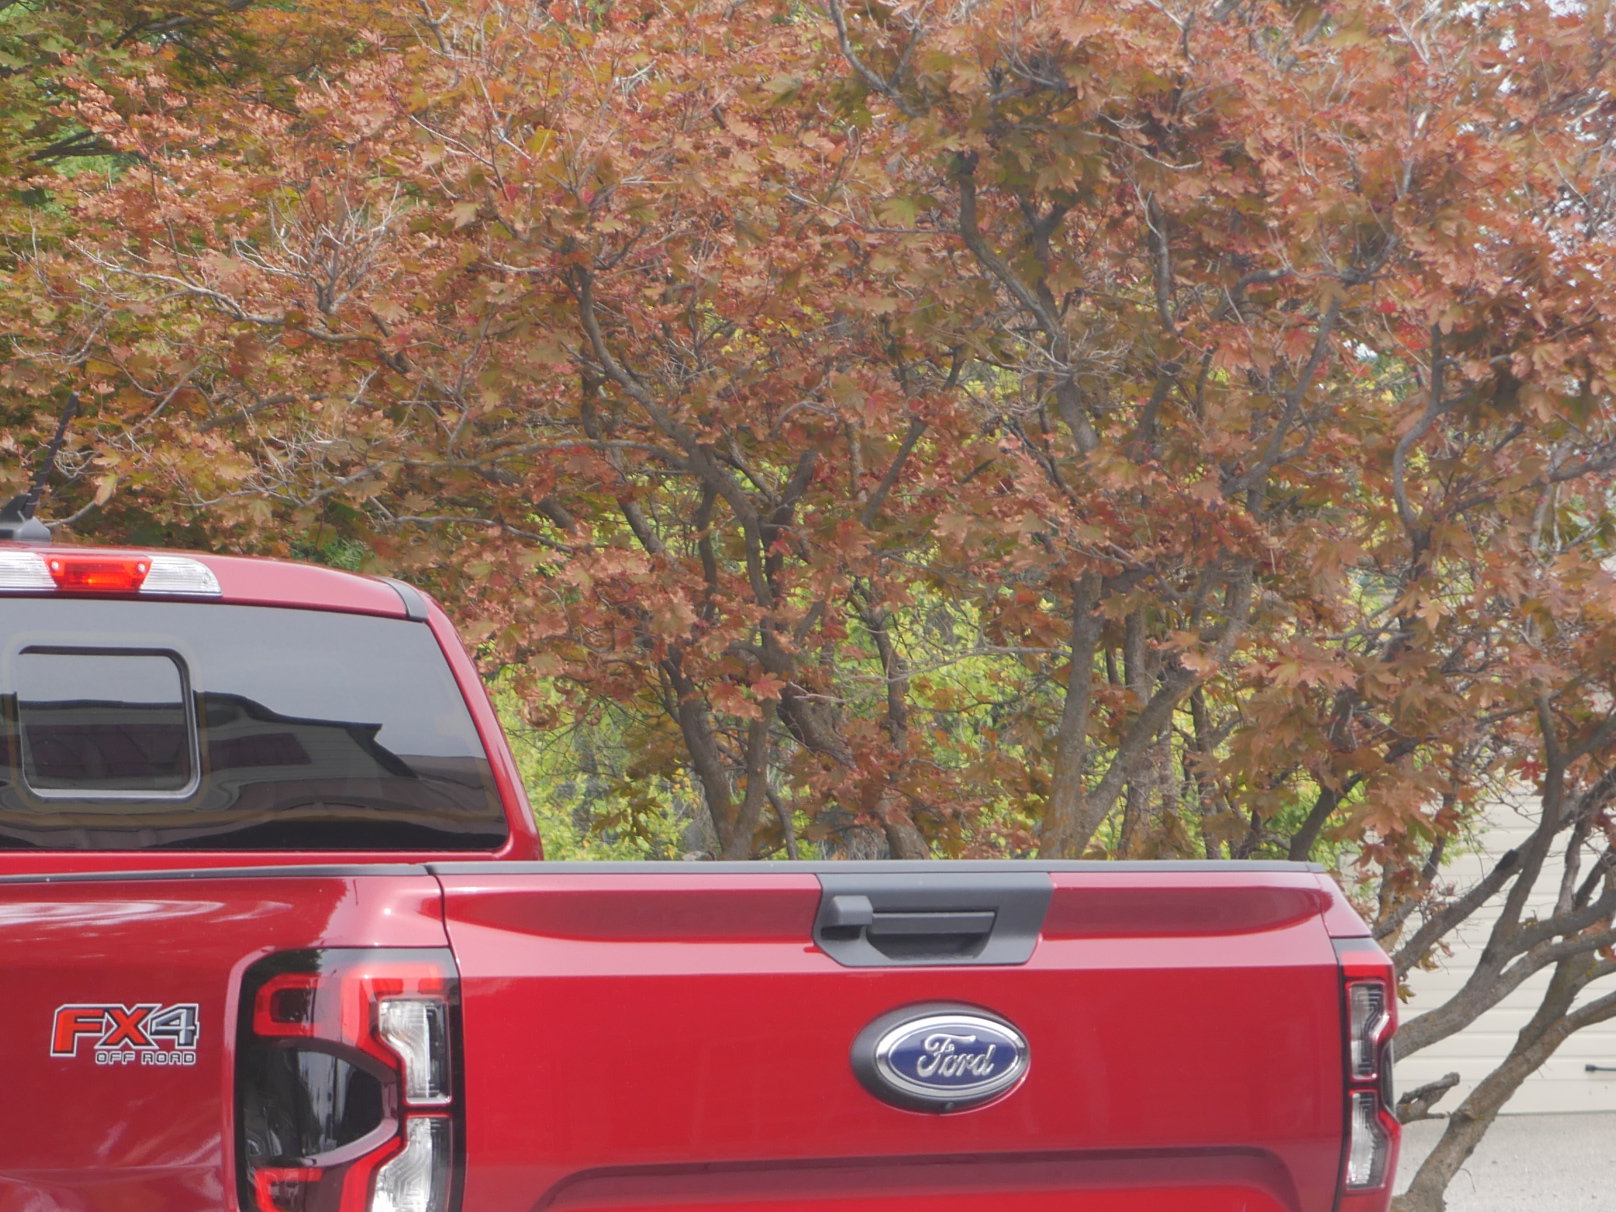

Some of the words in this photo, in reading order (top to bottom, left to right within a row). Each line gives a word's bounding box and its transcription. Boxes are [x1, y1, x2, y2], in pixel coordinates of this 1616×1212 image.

[50, 1004, 199, 1057] FX4
[95, 1051, 135, 1065] OFF
[141, 1051, 196, 1065] ROAD
[917, 1033, 997, 1078] Ford
